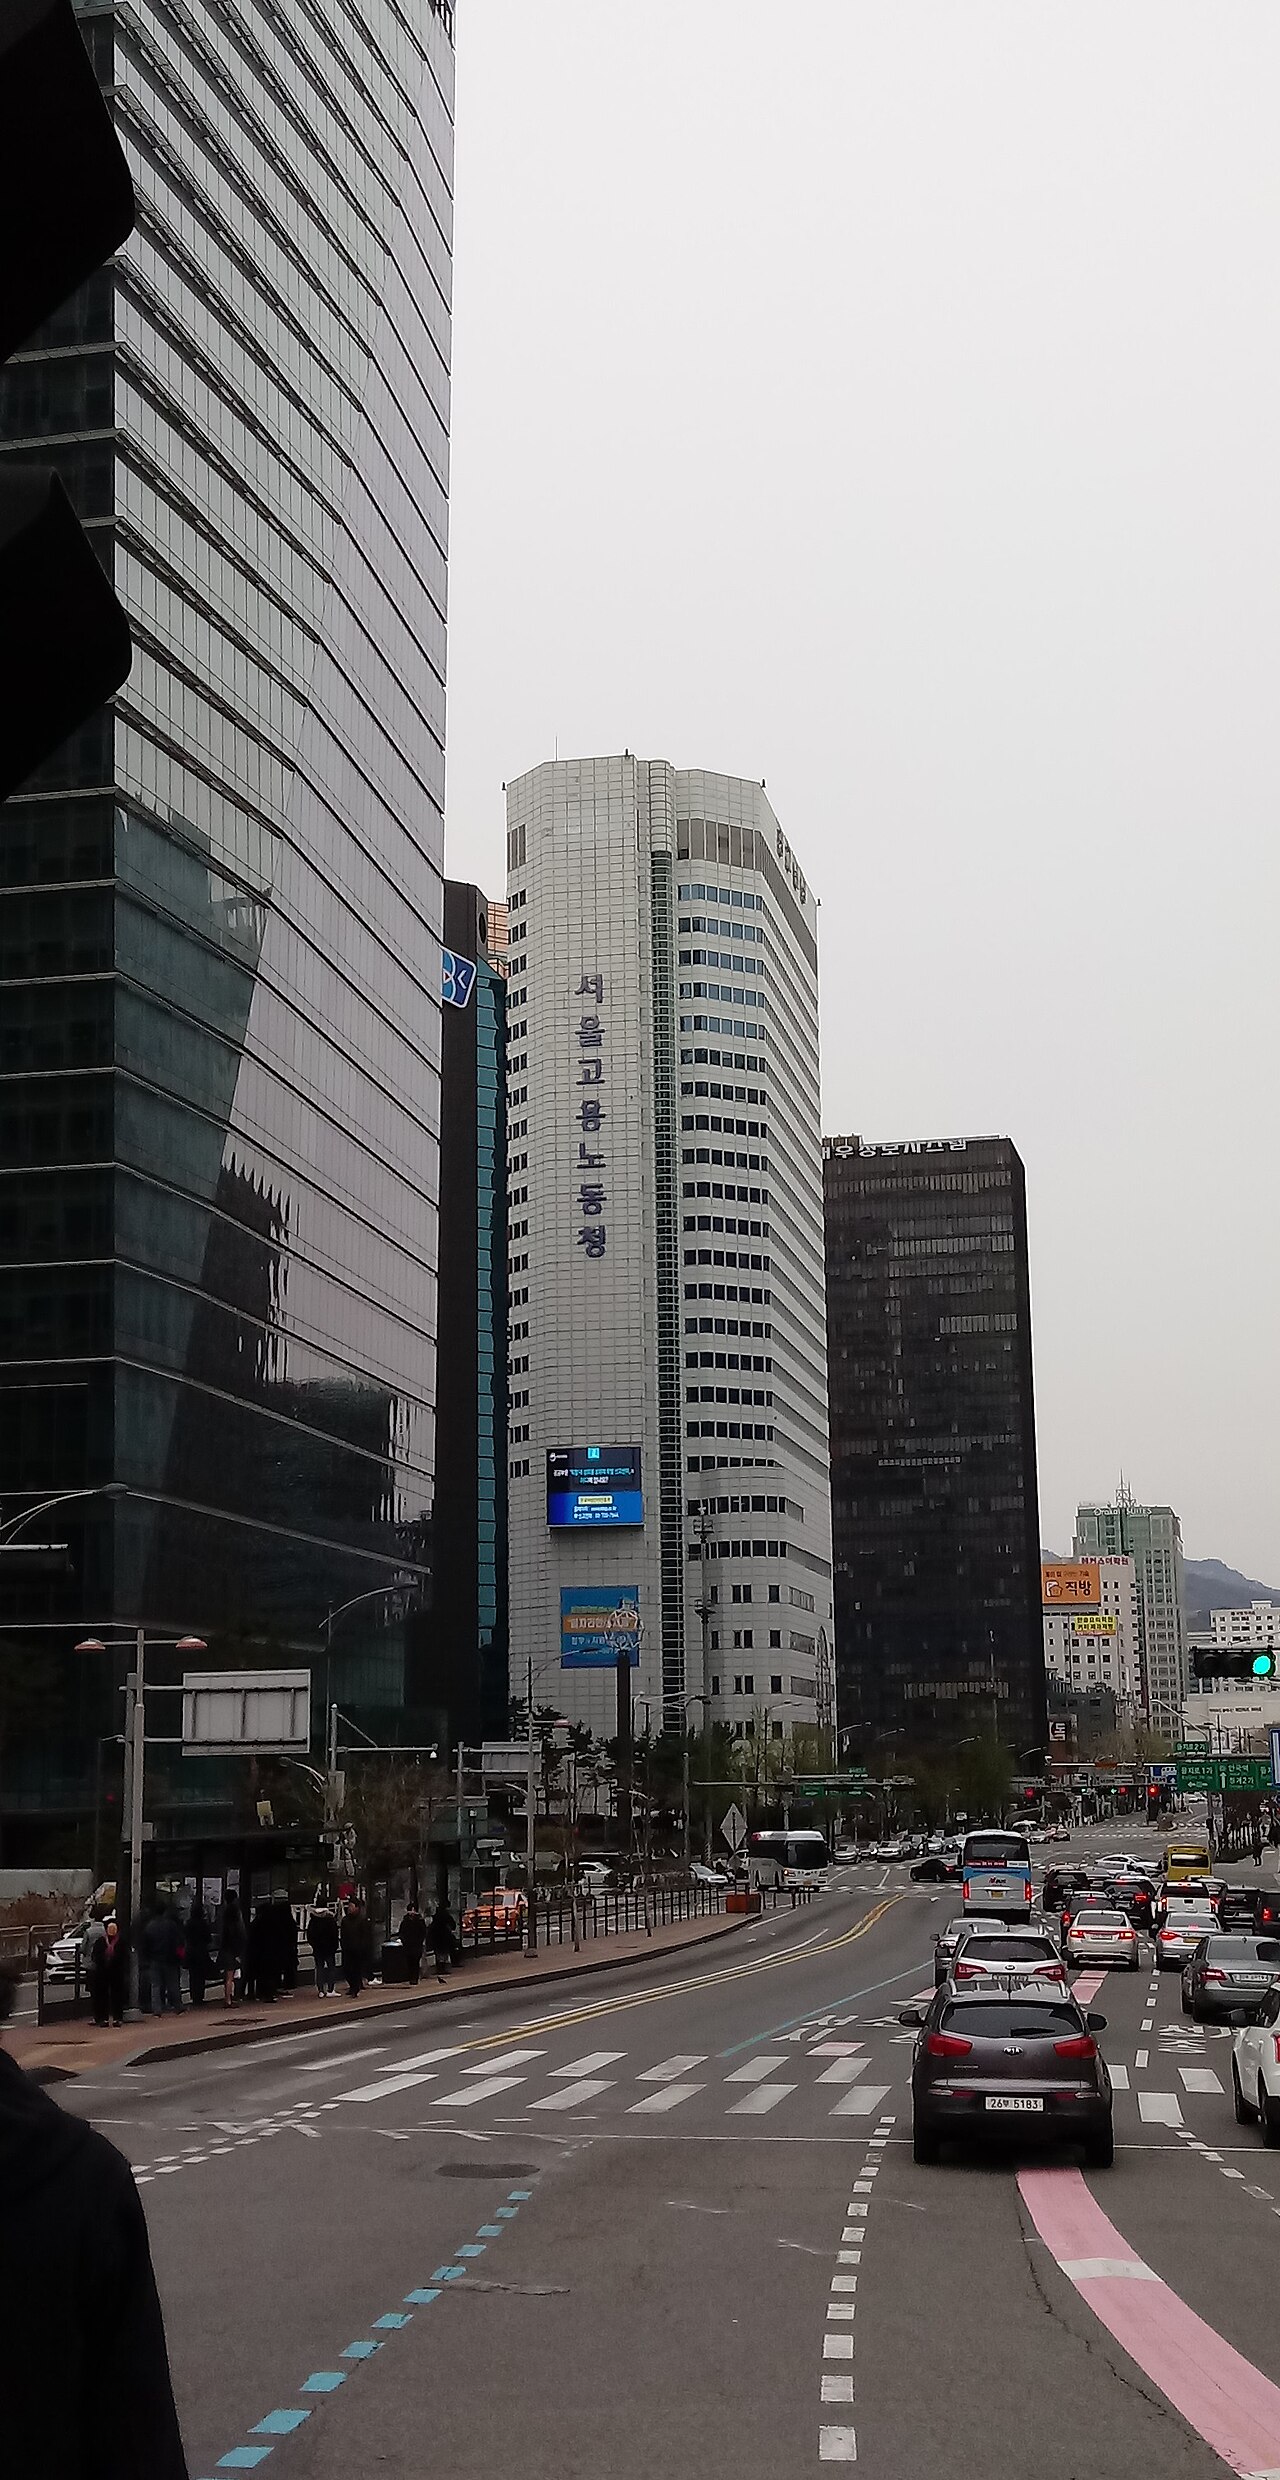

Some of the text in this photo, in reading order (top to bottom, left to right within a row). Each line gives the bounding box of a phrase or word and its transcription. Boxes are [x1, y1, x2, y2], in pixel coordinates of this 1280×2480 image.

[574, 972, 608, 1259] 서울고용노동청
[1065, 1580, 1092, 1597] 직방
[1013, 2099, 1039, 2110] 5183
